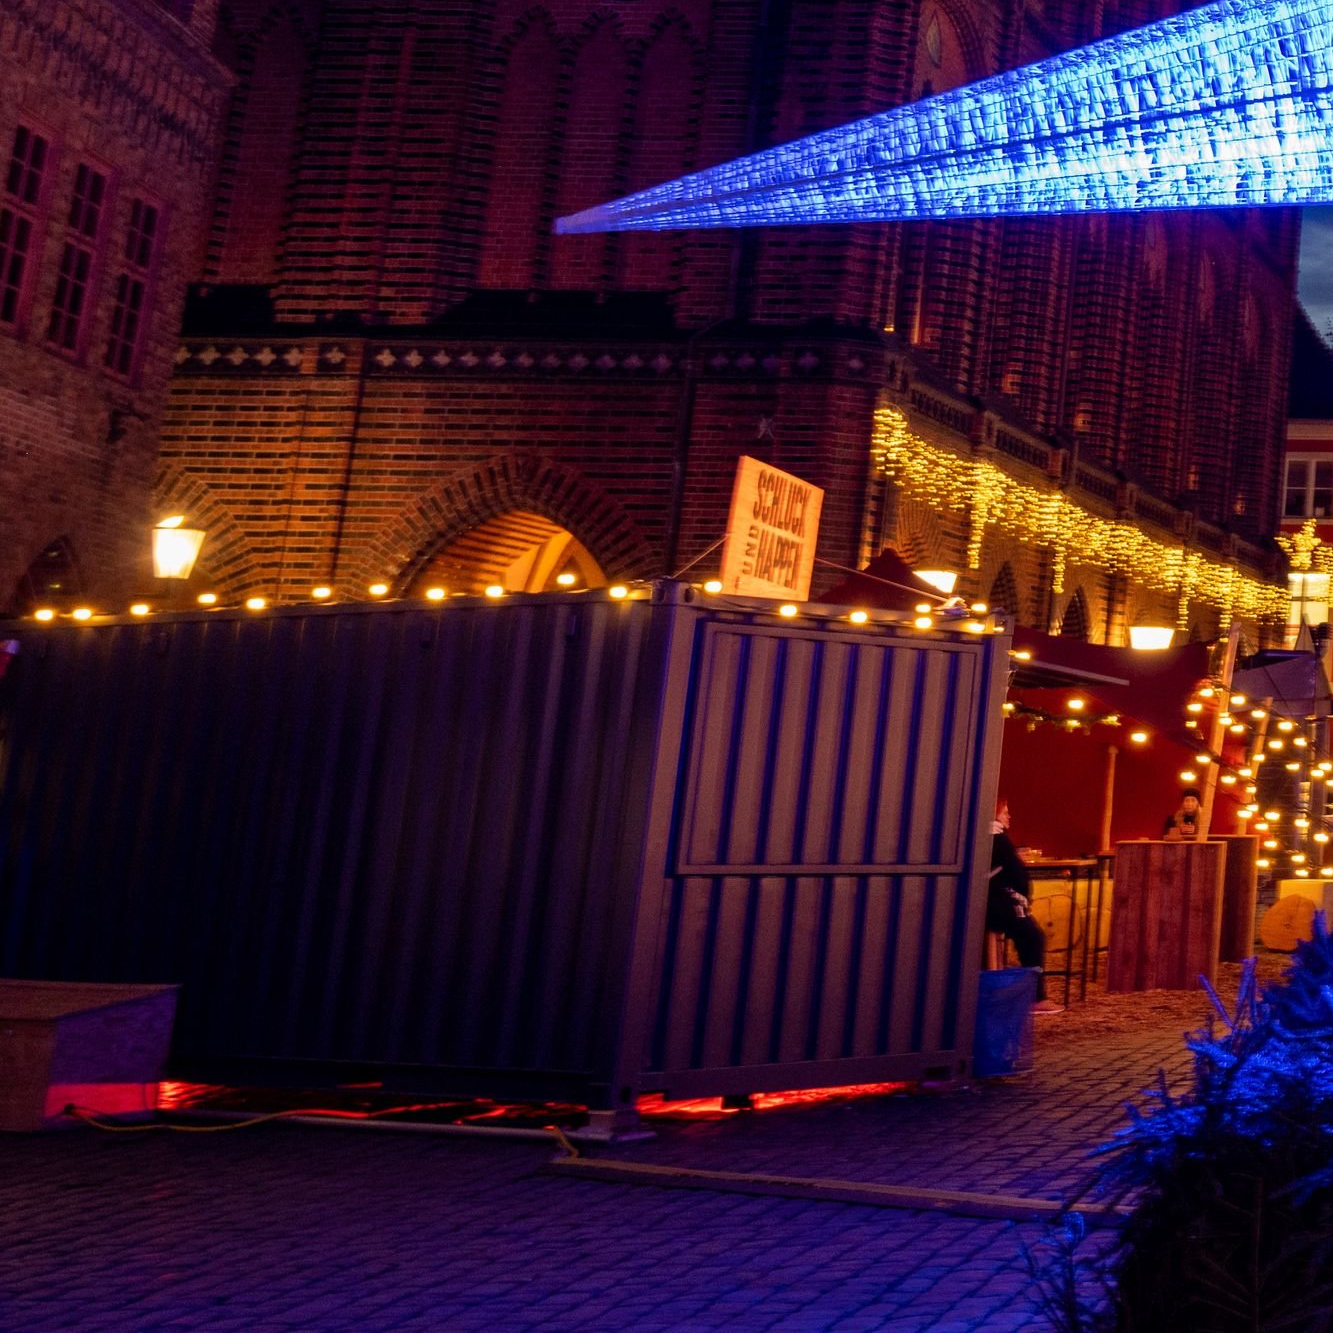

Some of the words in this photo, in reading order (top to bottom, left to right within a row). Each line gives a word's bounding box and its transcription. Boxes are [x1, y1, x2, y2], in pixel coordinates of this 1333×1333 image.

[752, 469, 812, 539] SCHLUCK
[742, 524, 760, 576] UND
[754, 529, 804, 591] HAPPEN
